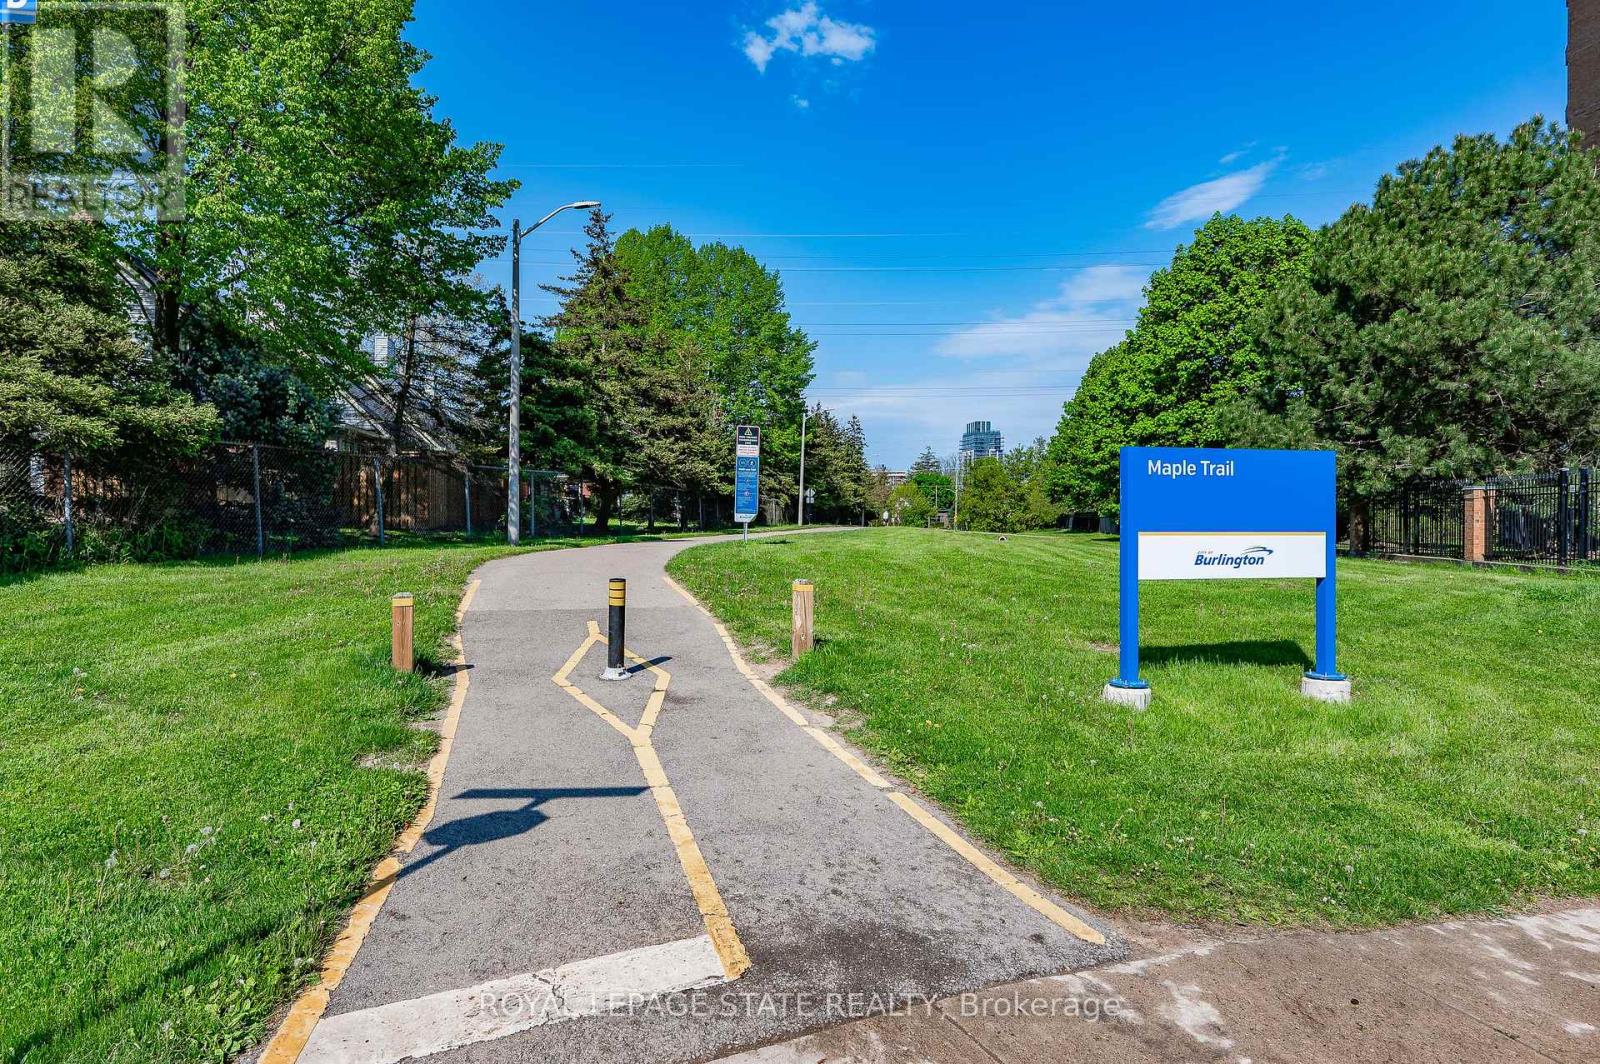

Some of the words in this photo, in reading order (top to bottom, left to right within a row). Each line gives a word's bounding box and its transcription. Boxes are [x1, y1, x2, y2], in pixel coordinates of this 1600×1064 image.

[1147, 459, 1197, 479] Maple
[1200, 460, 1234, 477] Trail
[1194, 553, 1265, 569] Burlington
